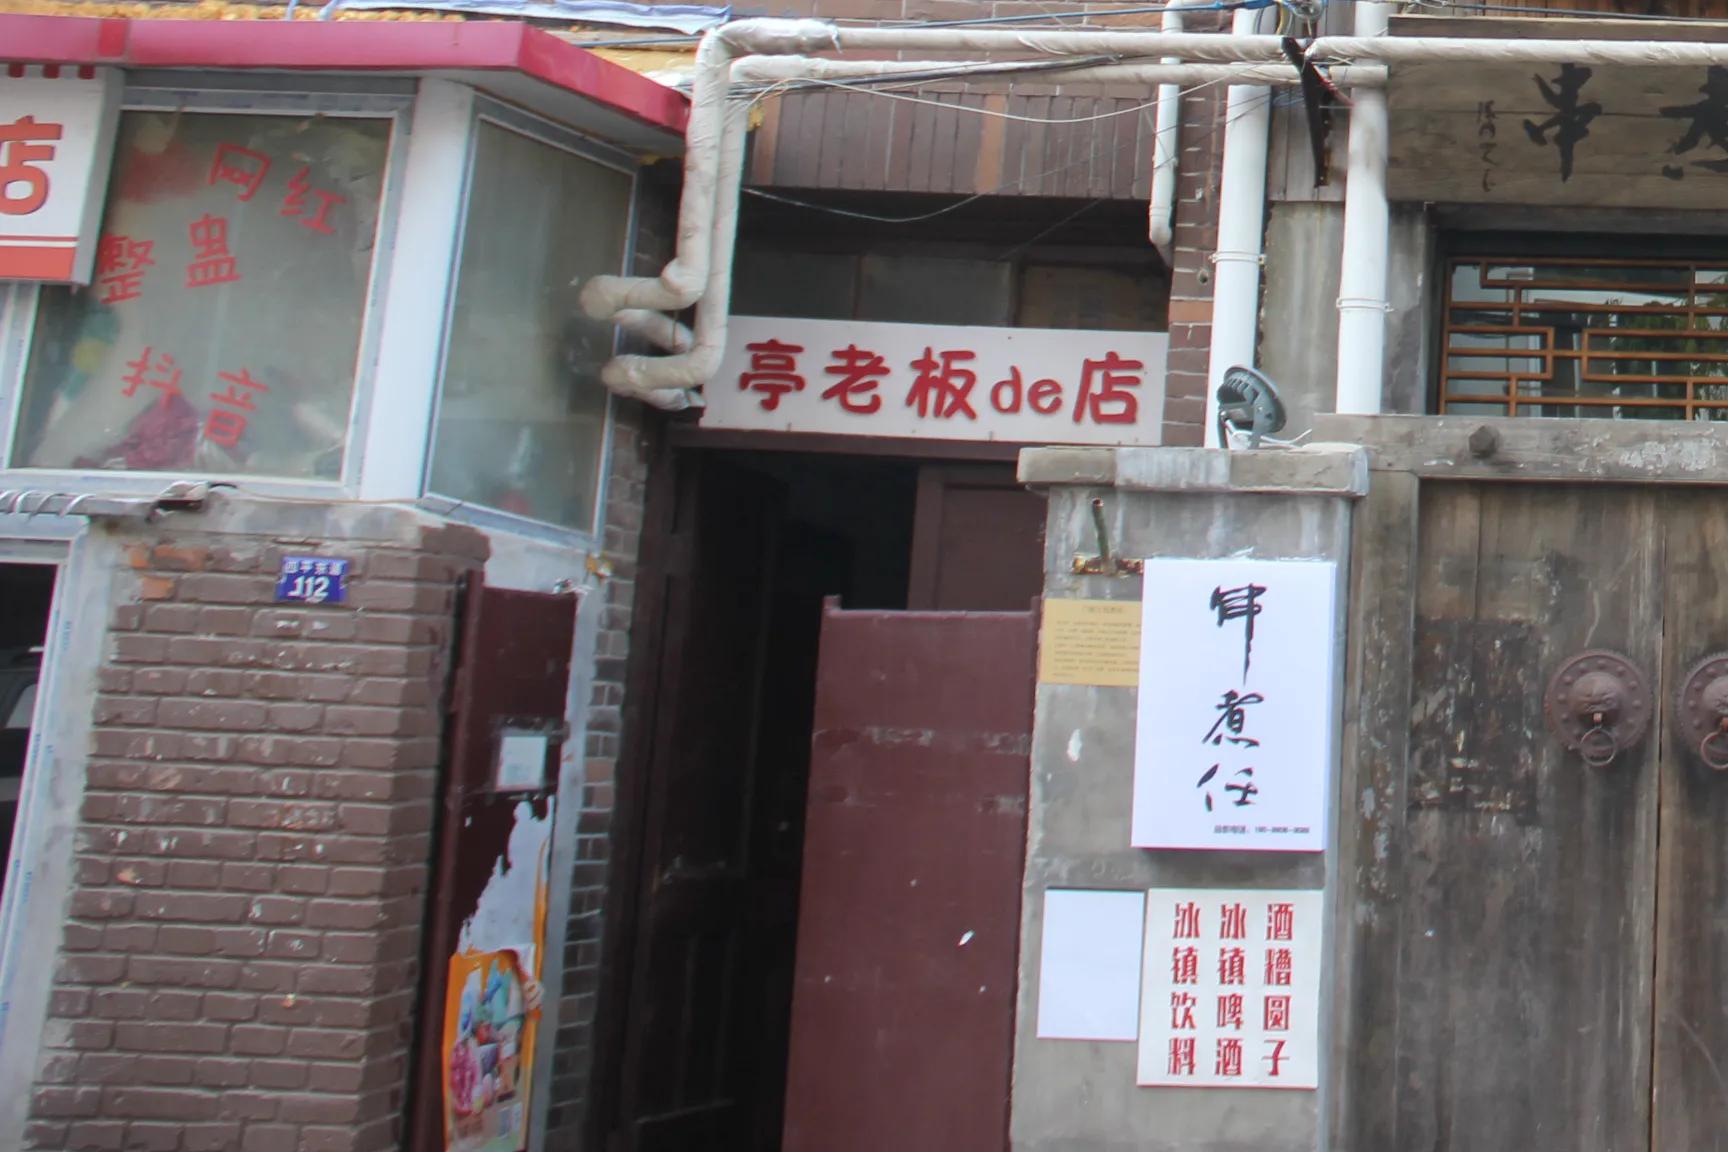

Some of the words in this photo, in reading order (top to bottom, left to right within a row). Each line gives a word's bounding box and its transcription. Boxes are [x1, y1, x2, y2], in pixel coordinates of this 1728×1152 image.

[206, 144, 346, 235] 网红
[120, 346, 269, 448] 抖音
[739, 338, 1146, 426] 亭老板de店
[288, 575, 330, 602] 112
[1168, 902, 1201, 1077] 冰镇饮料
[1214, 903, 1248, 1077] 冰镇啤酒
[1261, 902, 1295, 1077] 酒糟圆子
